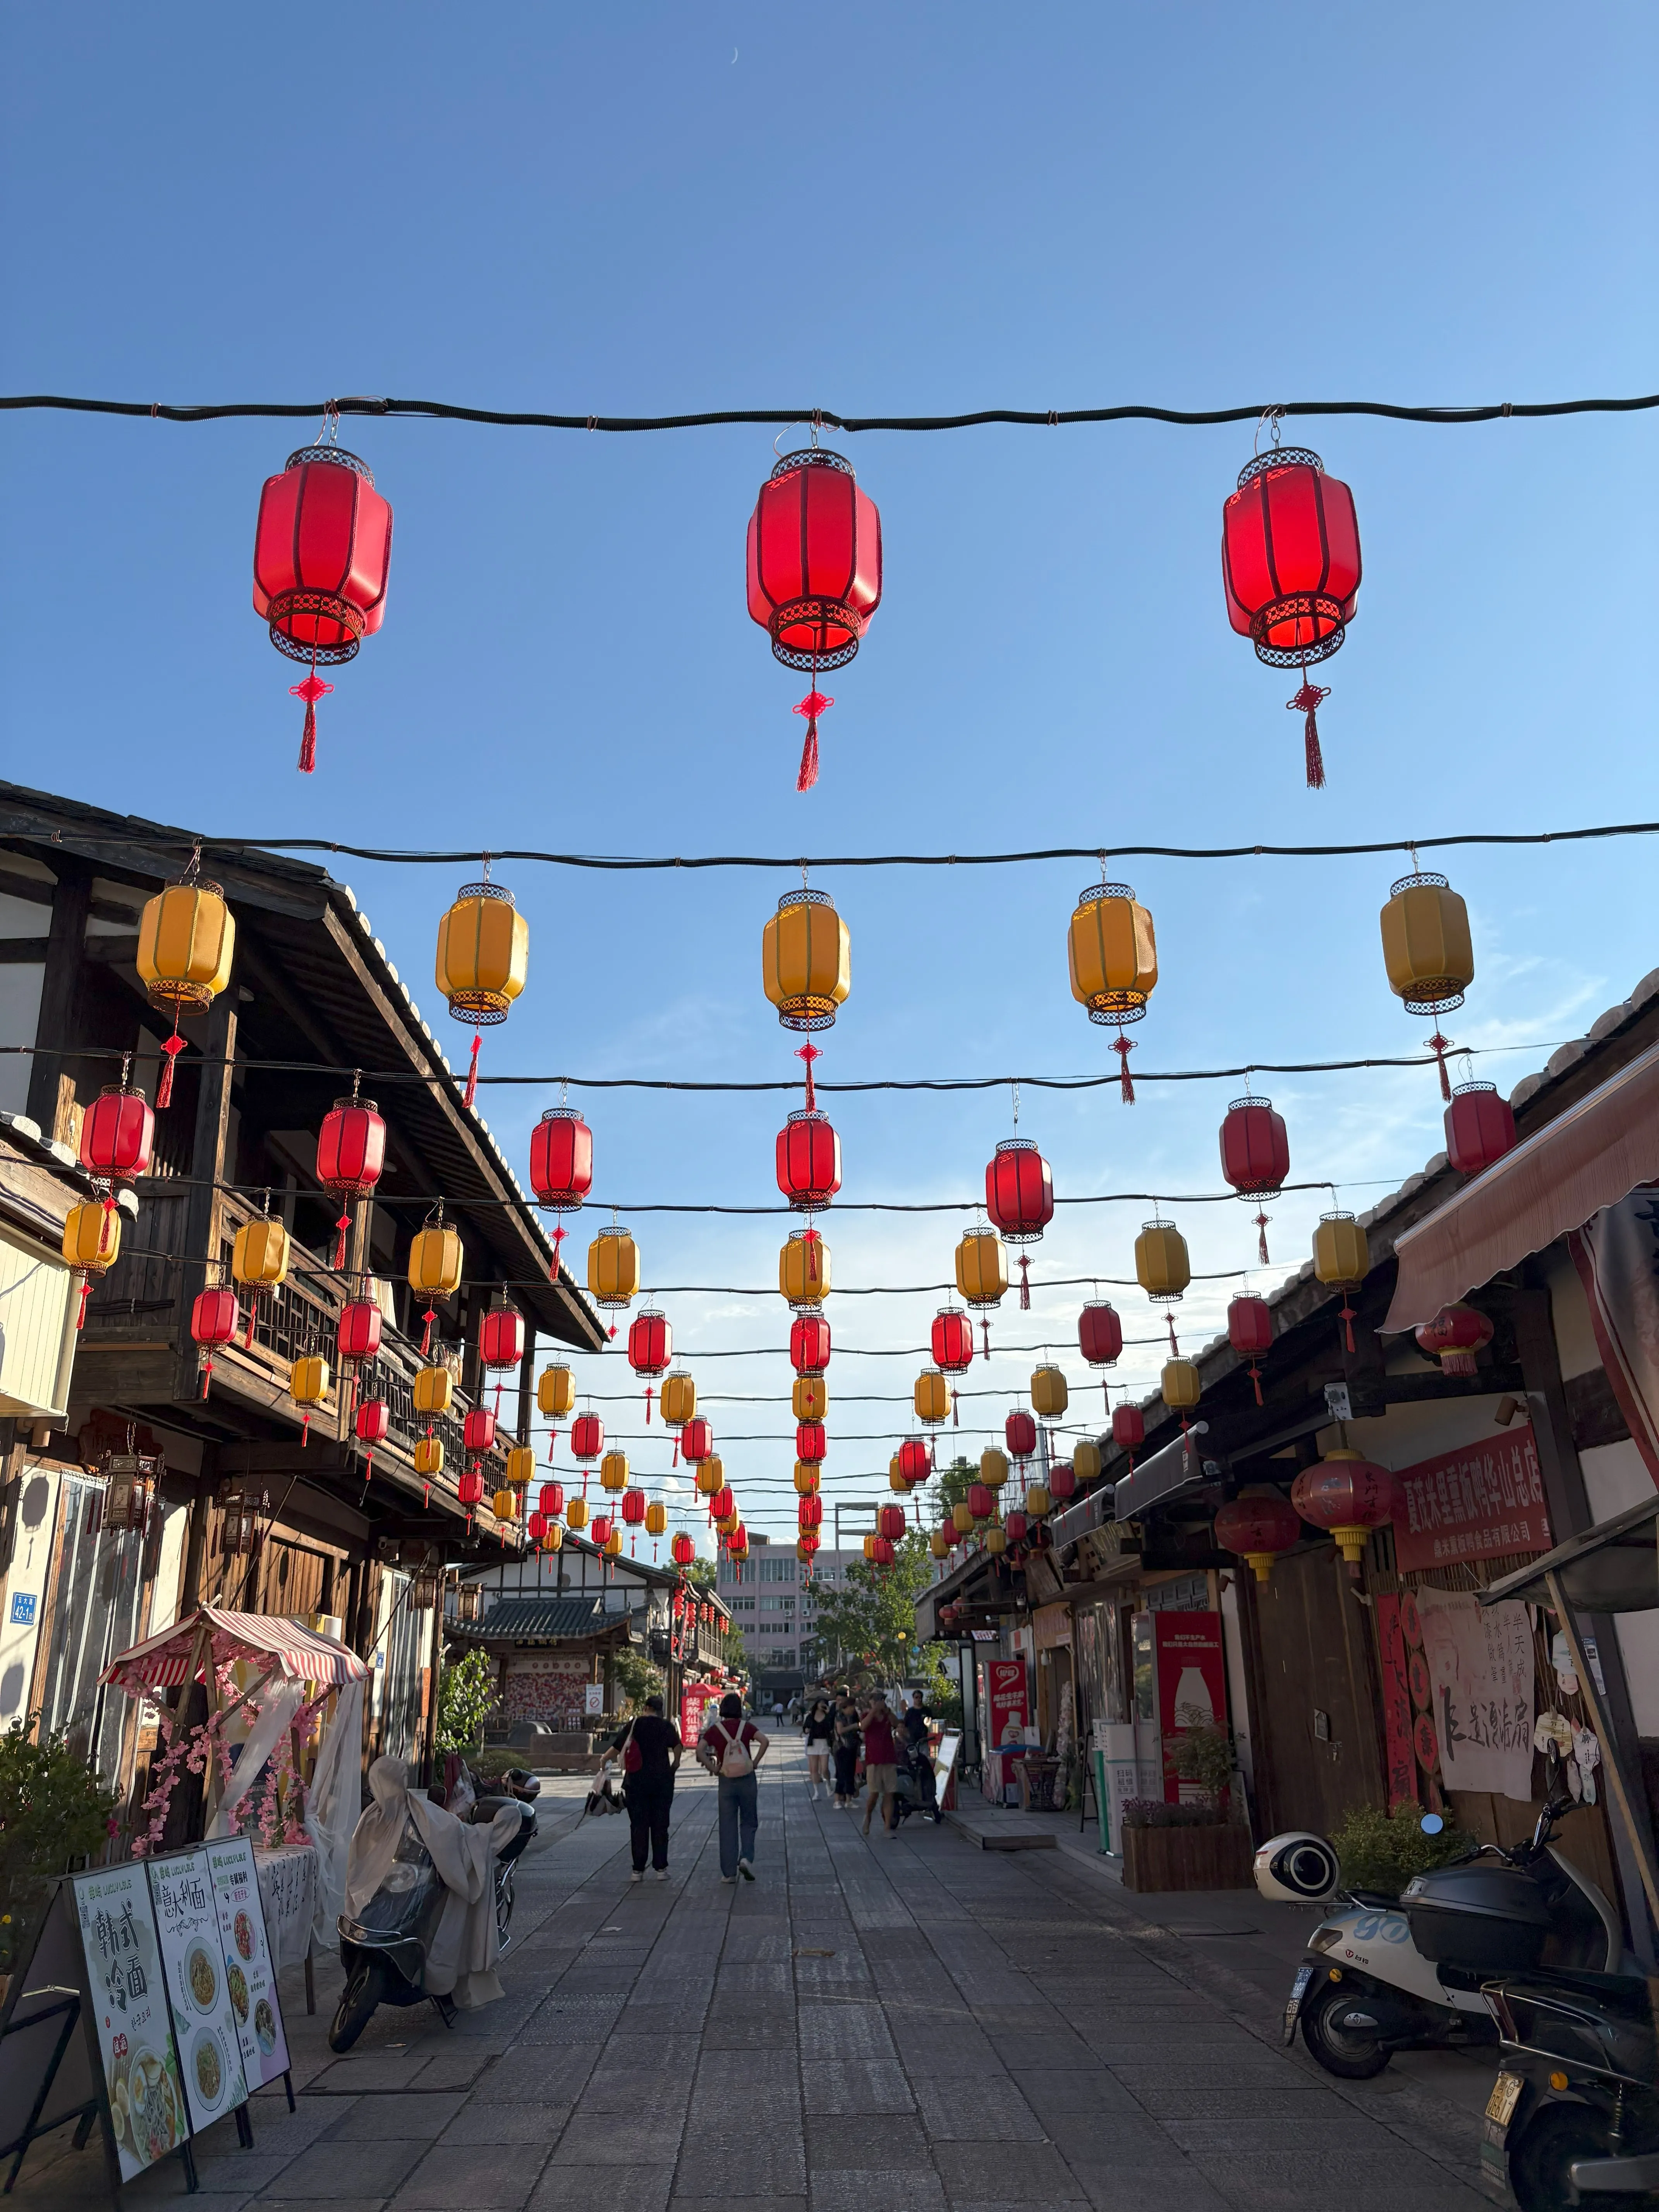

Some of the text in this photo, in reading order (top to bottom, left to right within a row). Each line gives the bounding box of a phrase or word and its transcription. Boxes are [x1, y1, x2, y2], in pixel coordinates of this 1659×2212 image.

[161, 1877, 206, 1918] 意大利面
[229, 1870, 249, 1886] 专属福利
[96, 1899, 140, 1961] 韩式
[105, 1954, 148, 2014] 冷面
